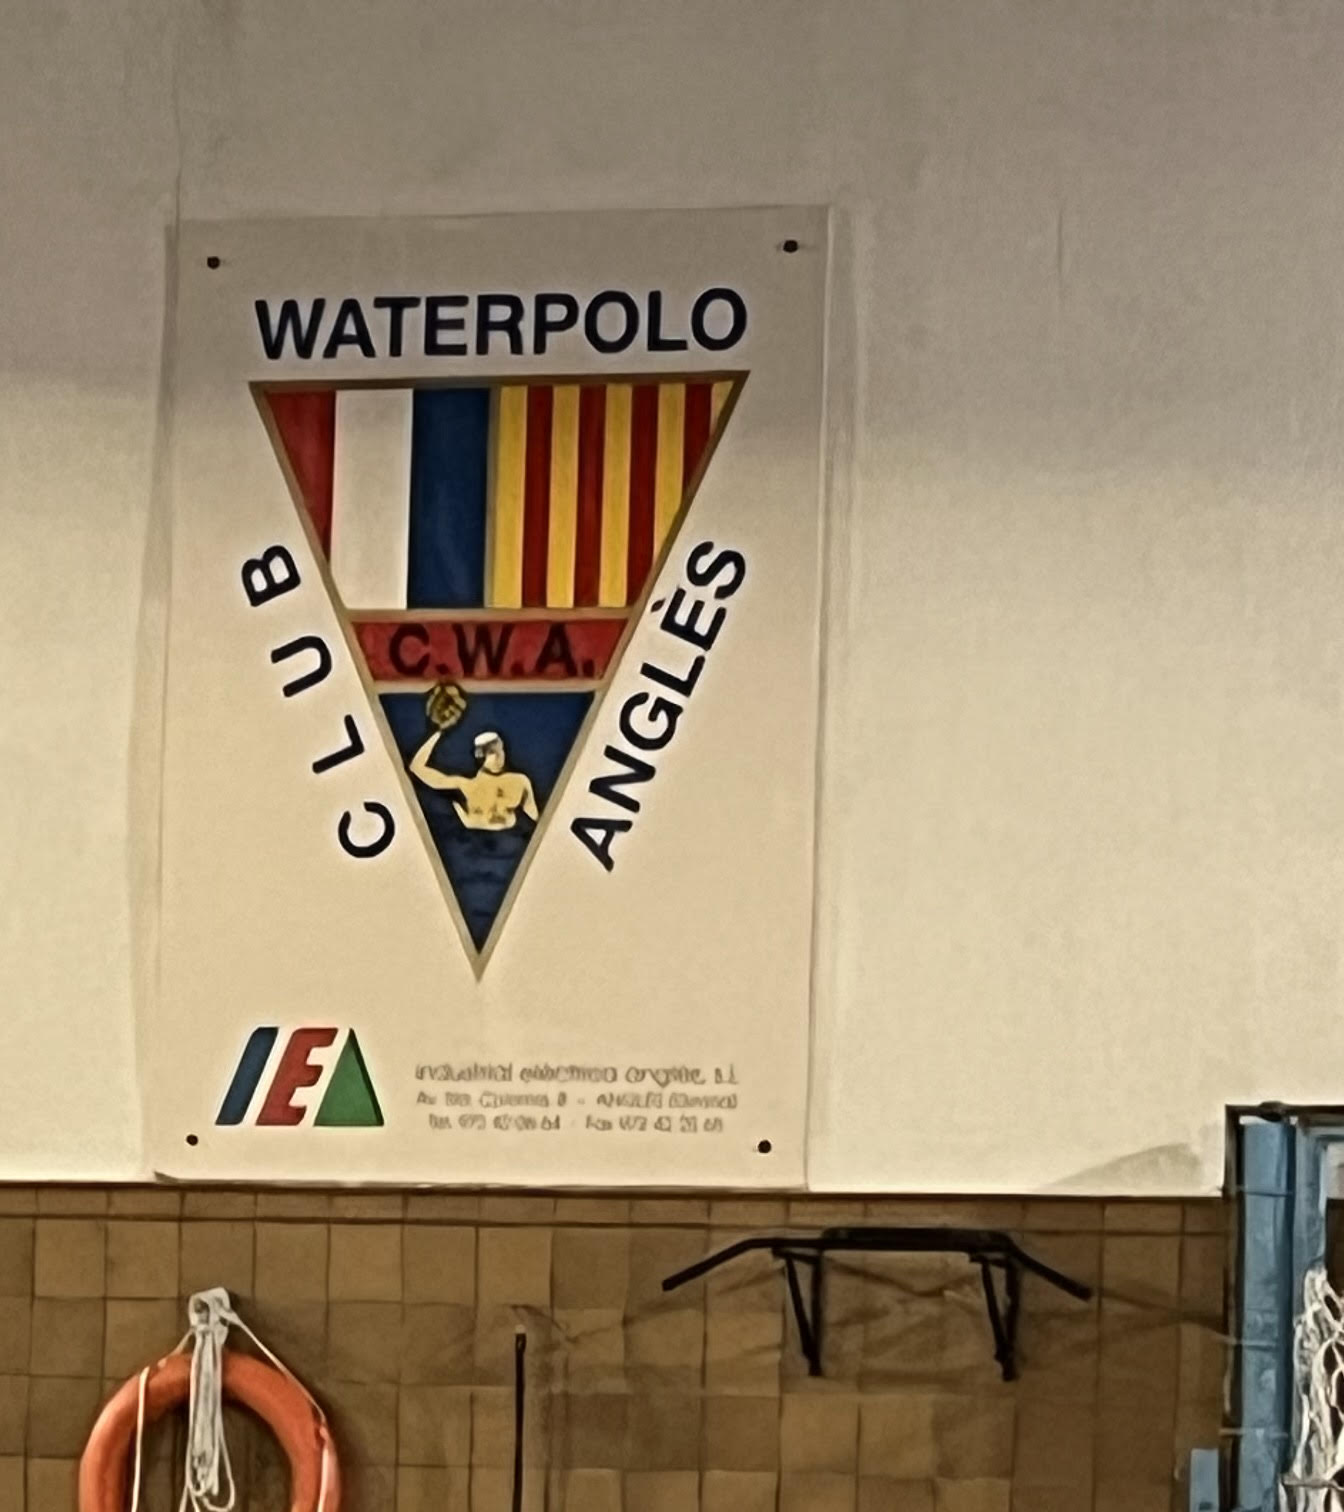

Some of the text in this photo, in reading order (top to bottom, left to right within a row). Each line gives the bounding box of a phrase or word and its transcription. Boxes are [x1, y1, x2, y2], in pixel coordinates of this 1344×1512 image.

[254, 287, 748, 360] WATERPOLO
[241, 545, 396, 858] CLUB
[389, 623, 596, 678] C.W.A.
[570, 541, 746, 872] ANGLÈS
